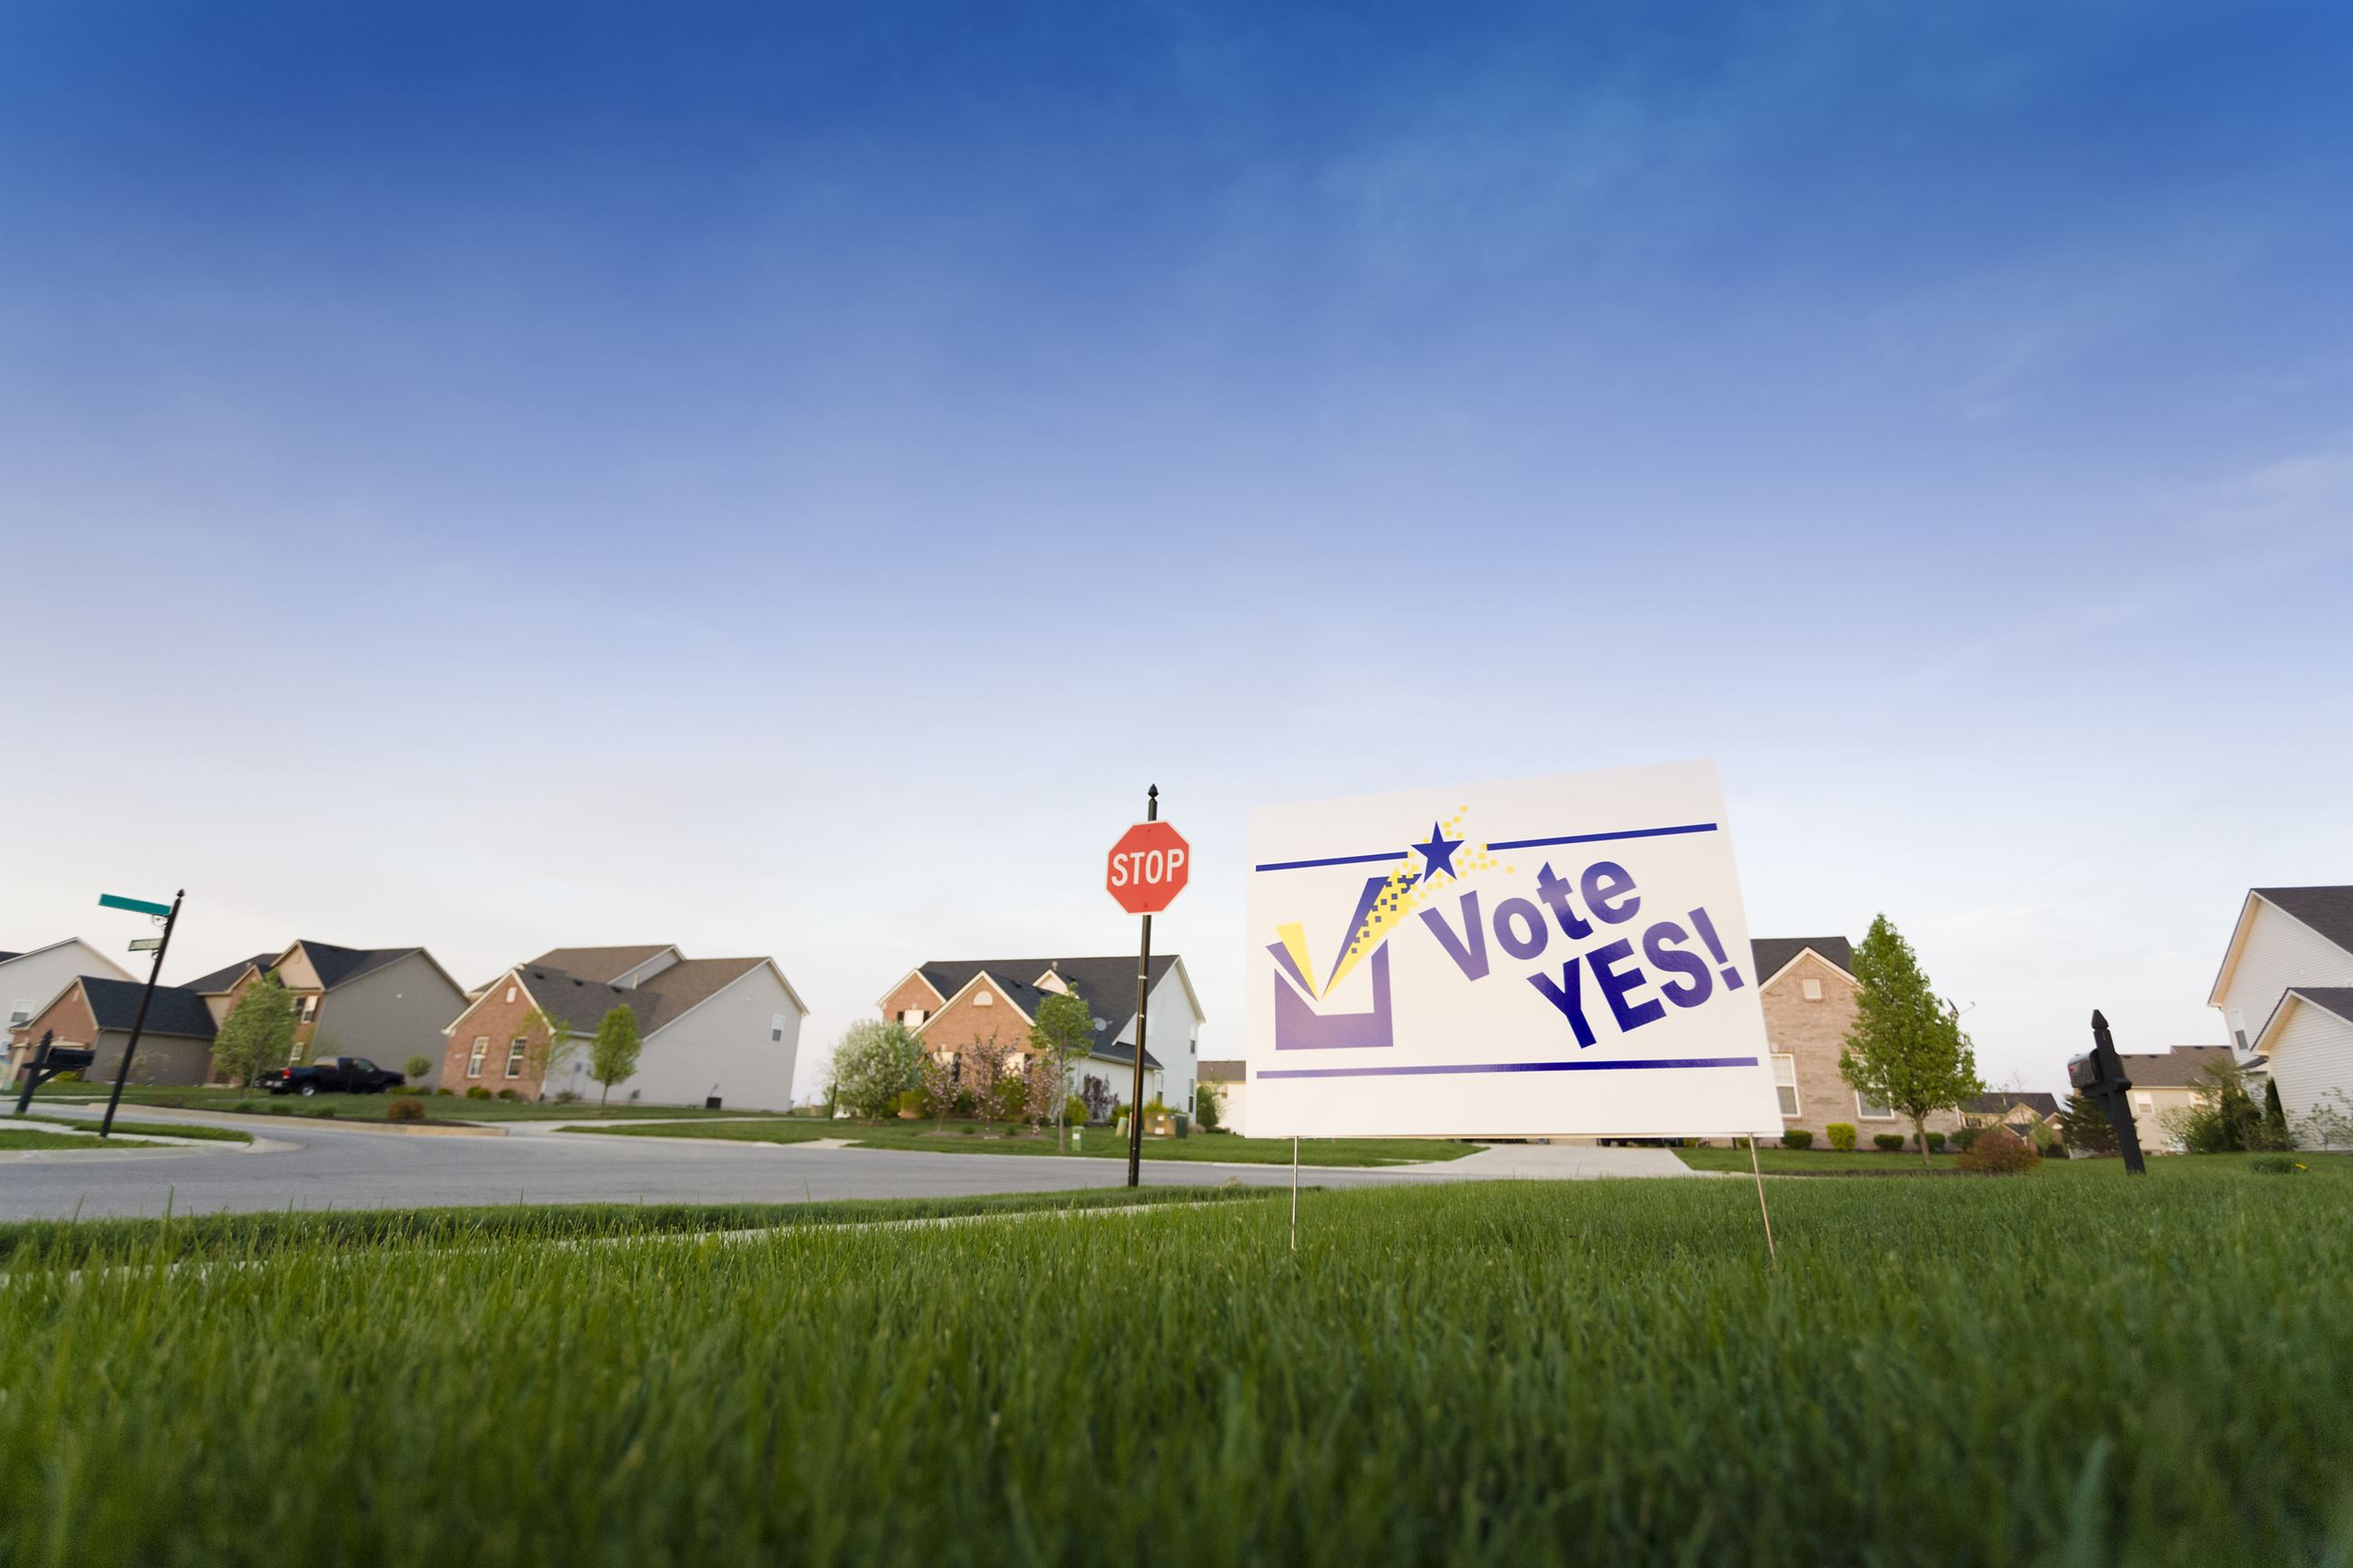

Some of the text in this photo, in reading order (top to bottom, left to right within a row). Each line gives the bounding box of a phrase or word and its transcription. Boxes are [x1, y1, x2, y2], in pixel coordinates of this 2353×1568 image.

[1110, 848, 1185, 887] STOP
[1418, 860, 1641, 982] Vote
[1527, 907, 1745, 1050] YES!
